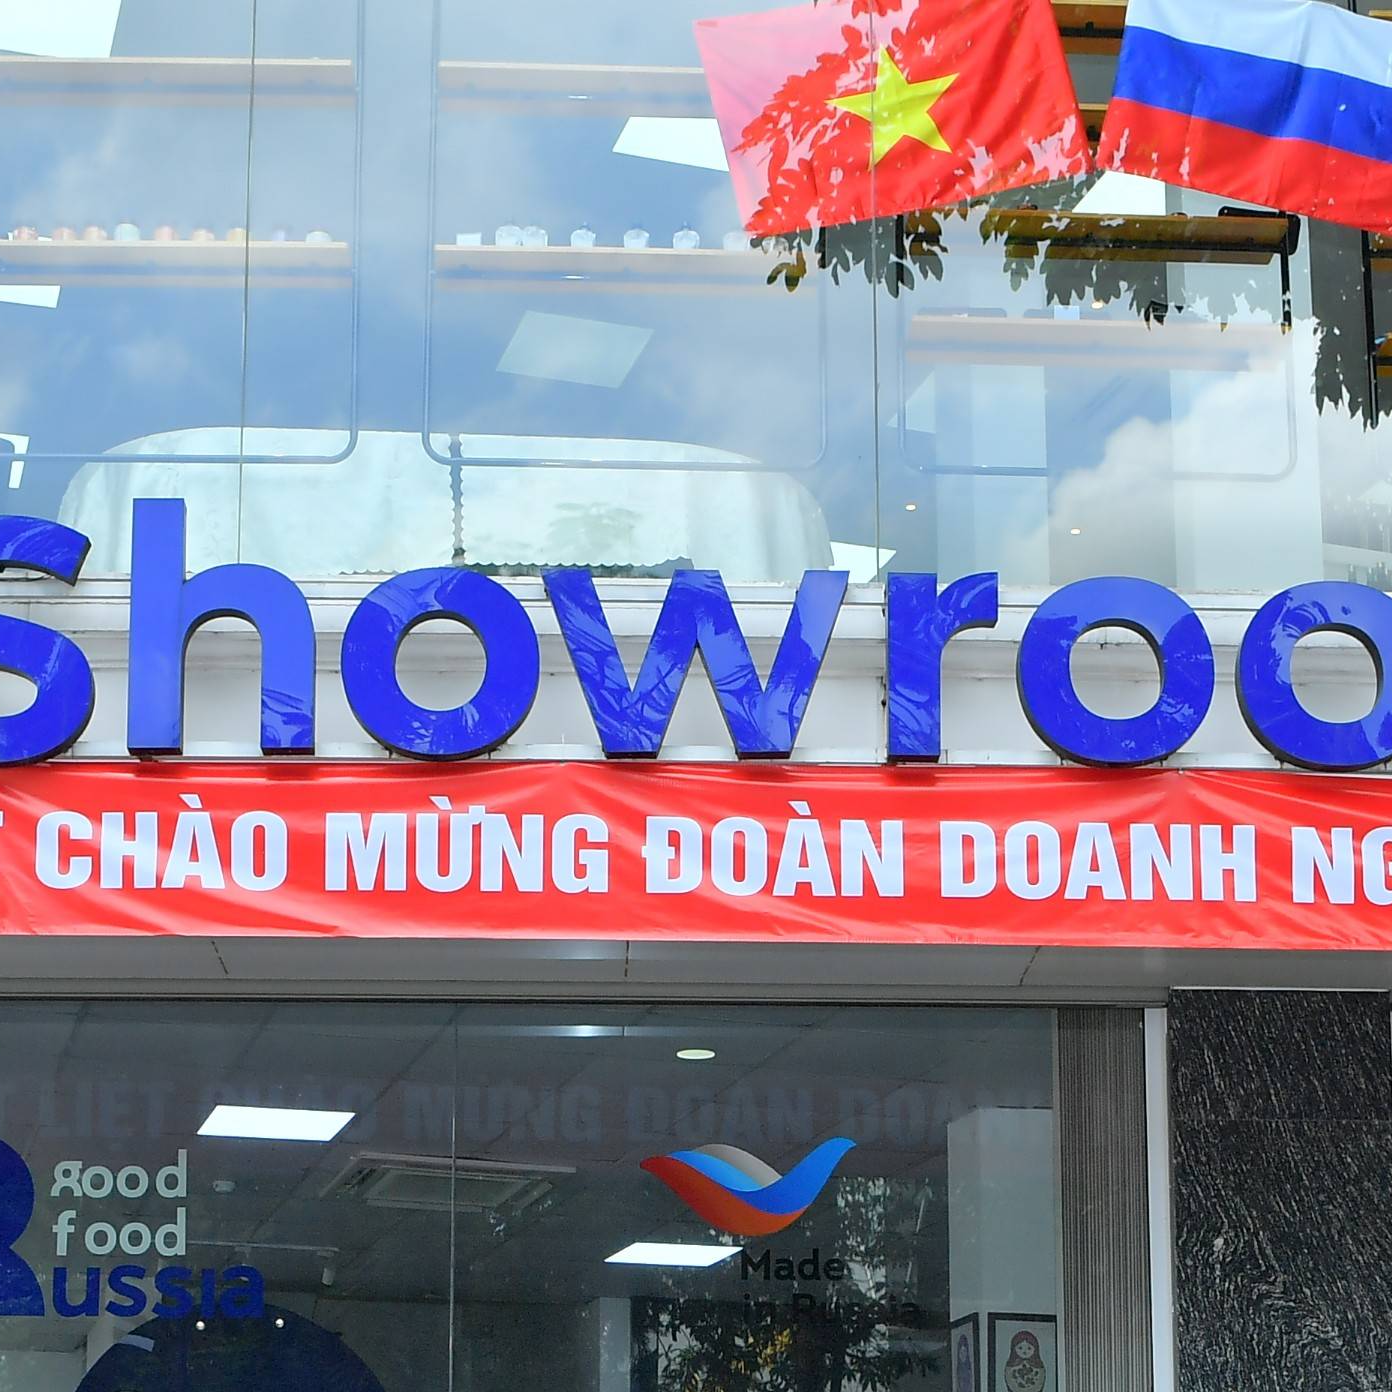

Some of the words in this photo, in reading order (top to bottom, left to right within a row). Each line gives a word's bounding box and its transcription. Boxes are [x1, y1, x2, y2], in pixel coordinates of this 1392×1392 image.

[35, 793, 289, 892] CHÀO
[324, 795, 611, 894] MỪNG
[641, 800, 906, 899] ĐOÀN
[939, 819, 1258, 902] DOANH
[51, 1207, 187, 1257] food
[741, 1248, 845, 1281] Made
